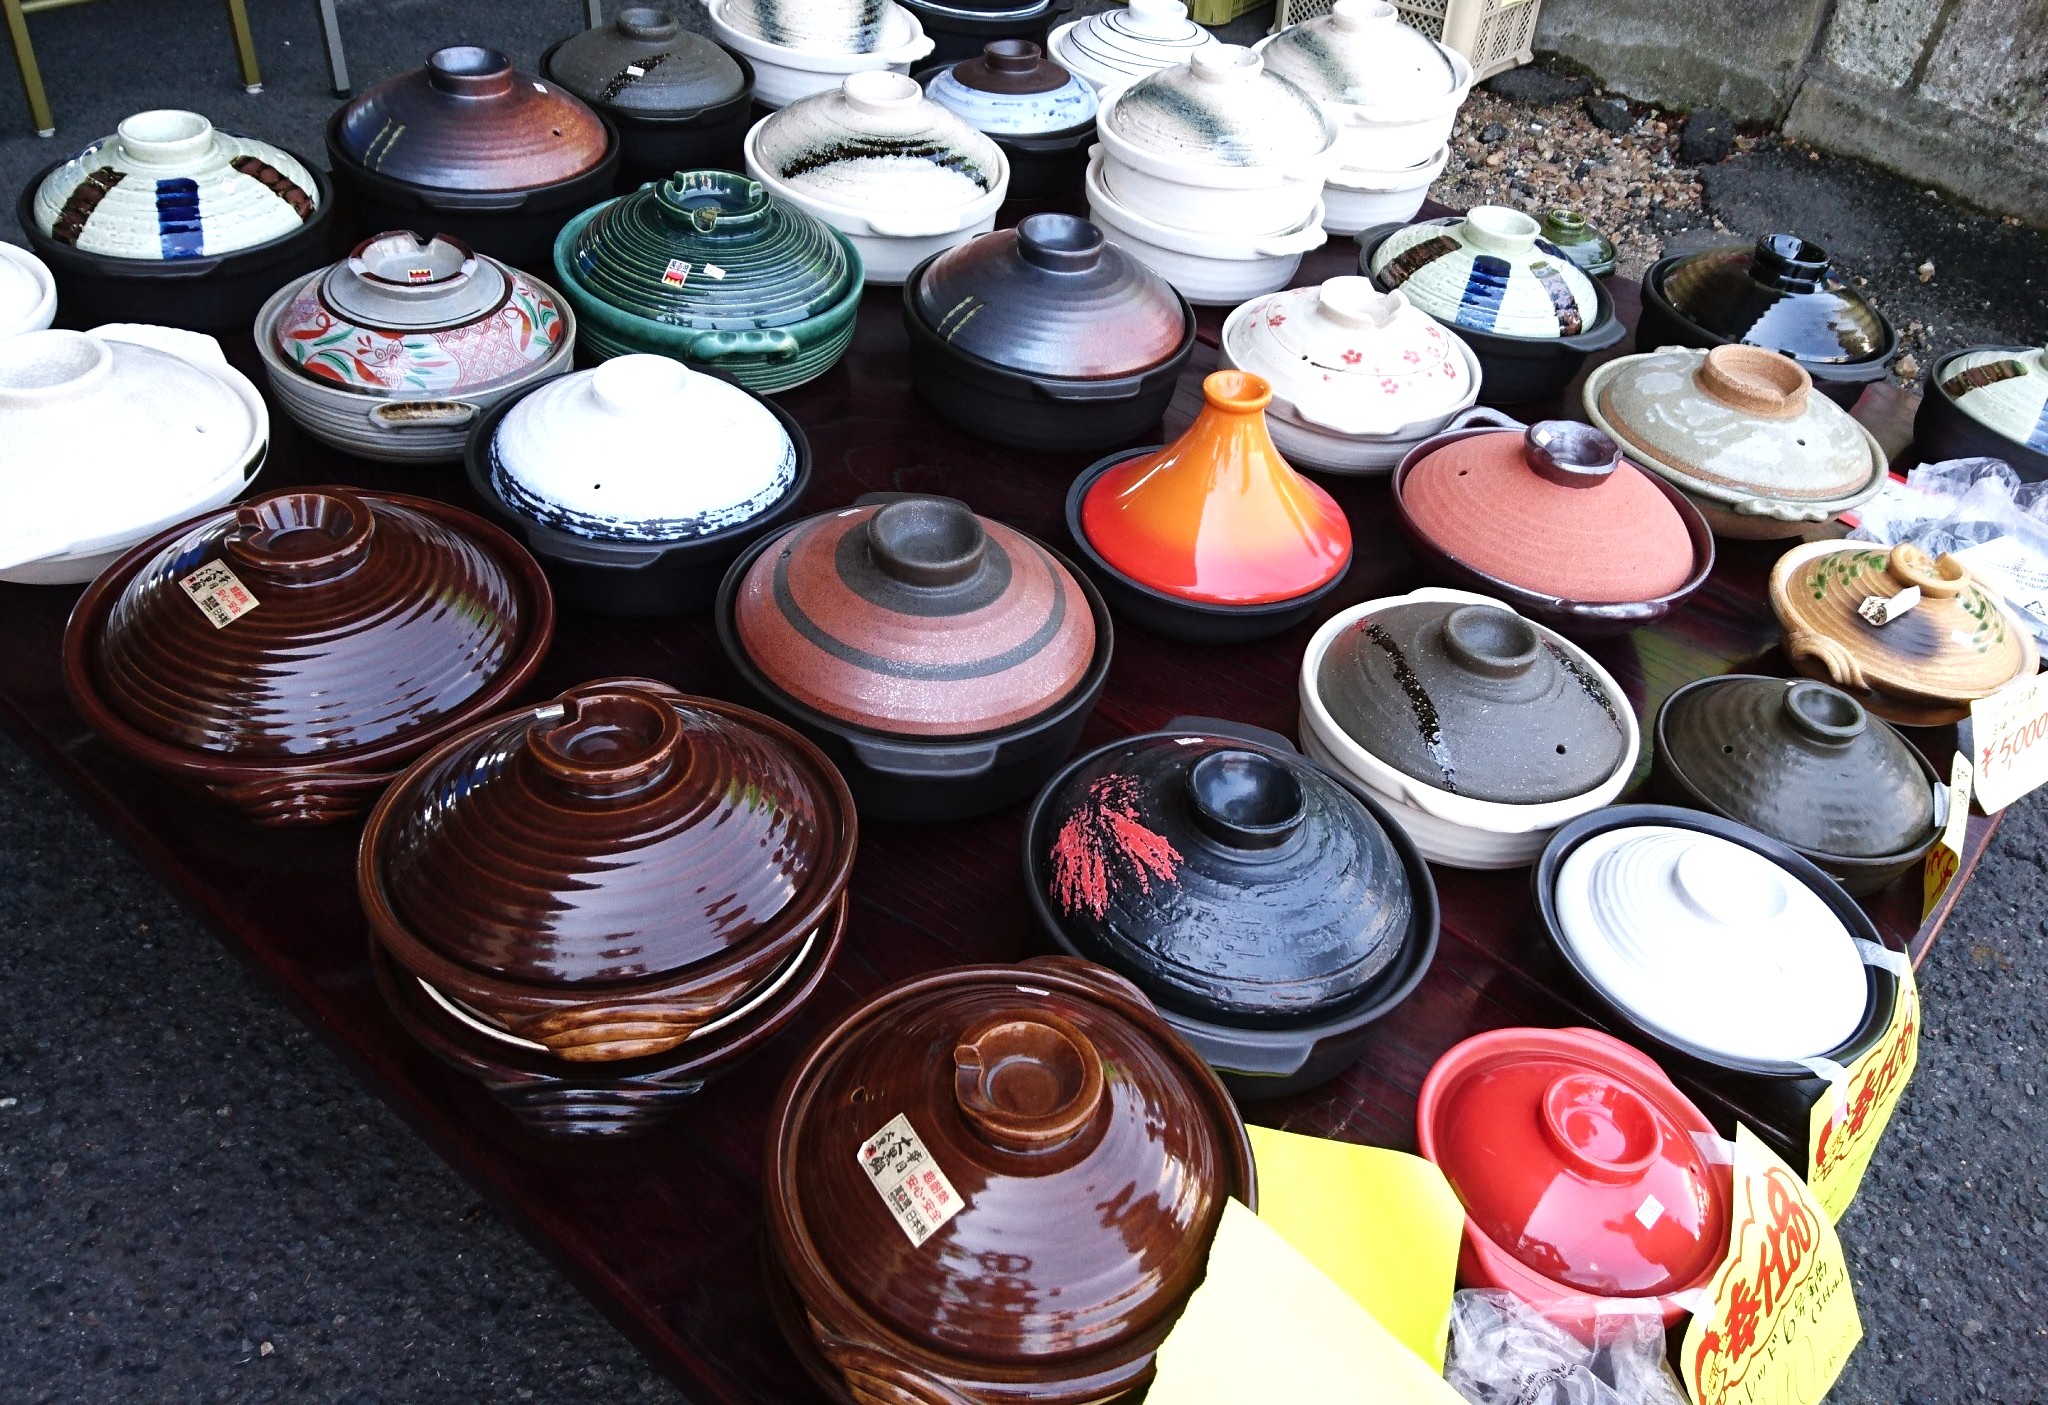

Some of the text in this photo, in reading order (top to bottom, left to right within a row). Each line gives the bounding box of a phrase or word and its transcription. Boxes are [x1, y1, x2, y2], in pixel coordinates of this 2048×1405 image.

[923, 1169, 950, 1205] 超耐熱
[906, 1209, 928, 1239] 日本製
